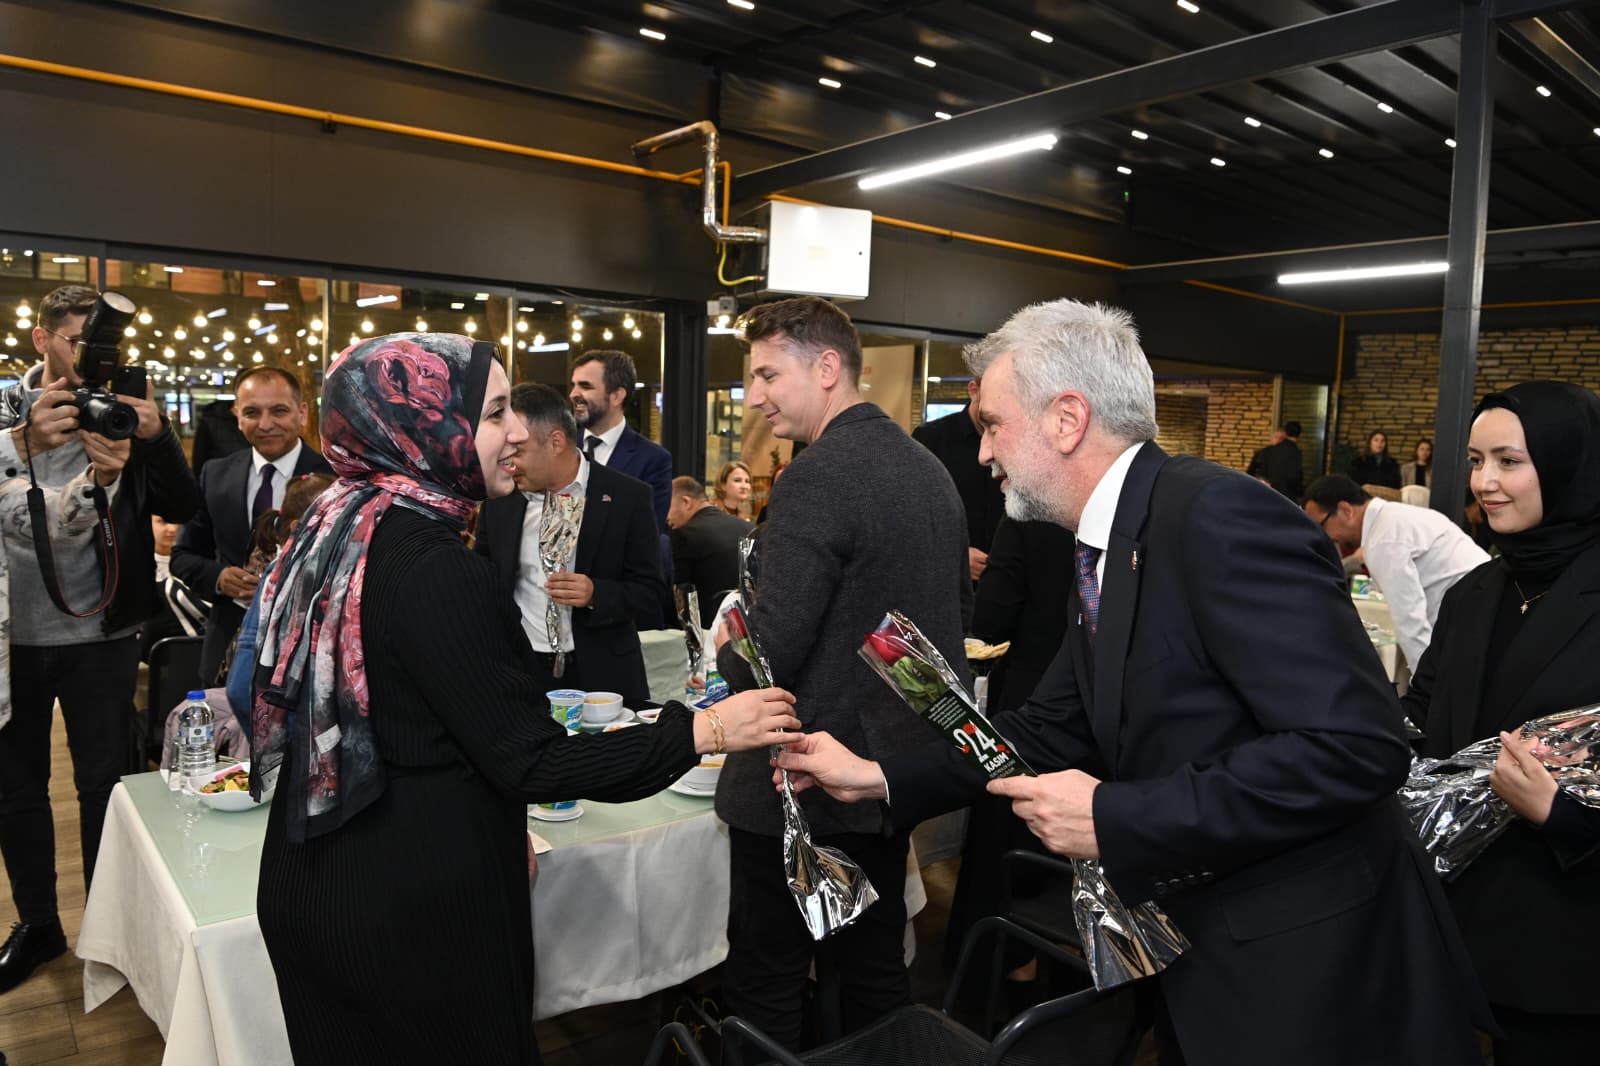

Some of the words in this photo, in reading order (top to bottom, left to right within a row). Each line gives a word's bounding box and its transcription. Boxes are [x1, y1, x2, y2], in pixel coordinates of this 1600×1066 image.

[102, 518, 113, 546] Canon
[953, 719, 998, 763] 24
[983, 752, 1009, 772] KASIM
